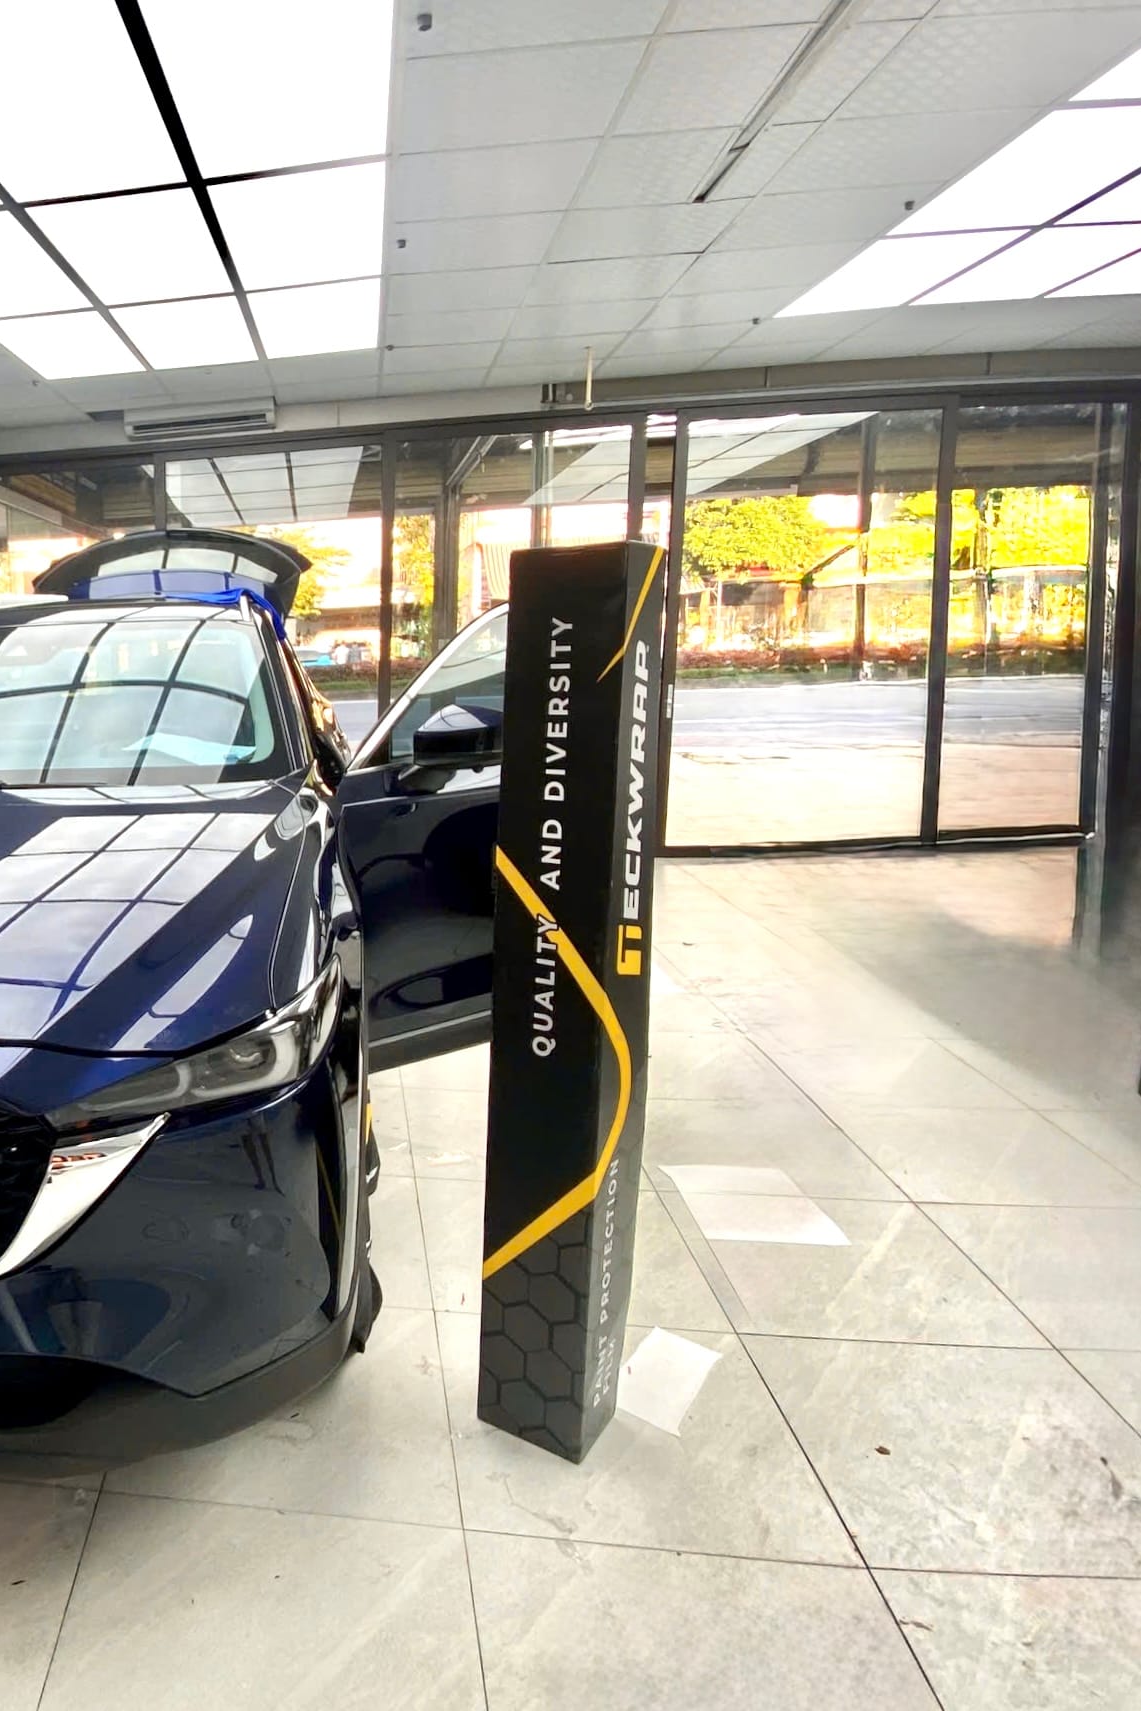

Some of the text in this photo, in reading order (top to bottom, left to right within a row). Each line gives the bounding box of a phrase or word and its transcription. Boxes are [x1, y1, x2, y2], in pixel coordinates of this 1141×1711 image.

[532, 616, 573, 1057] QUALITY AND DIVERSITY
[593, 1159, 619, 1408] PAINT PROTECTION
